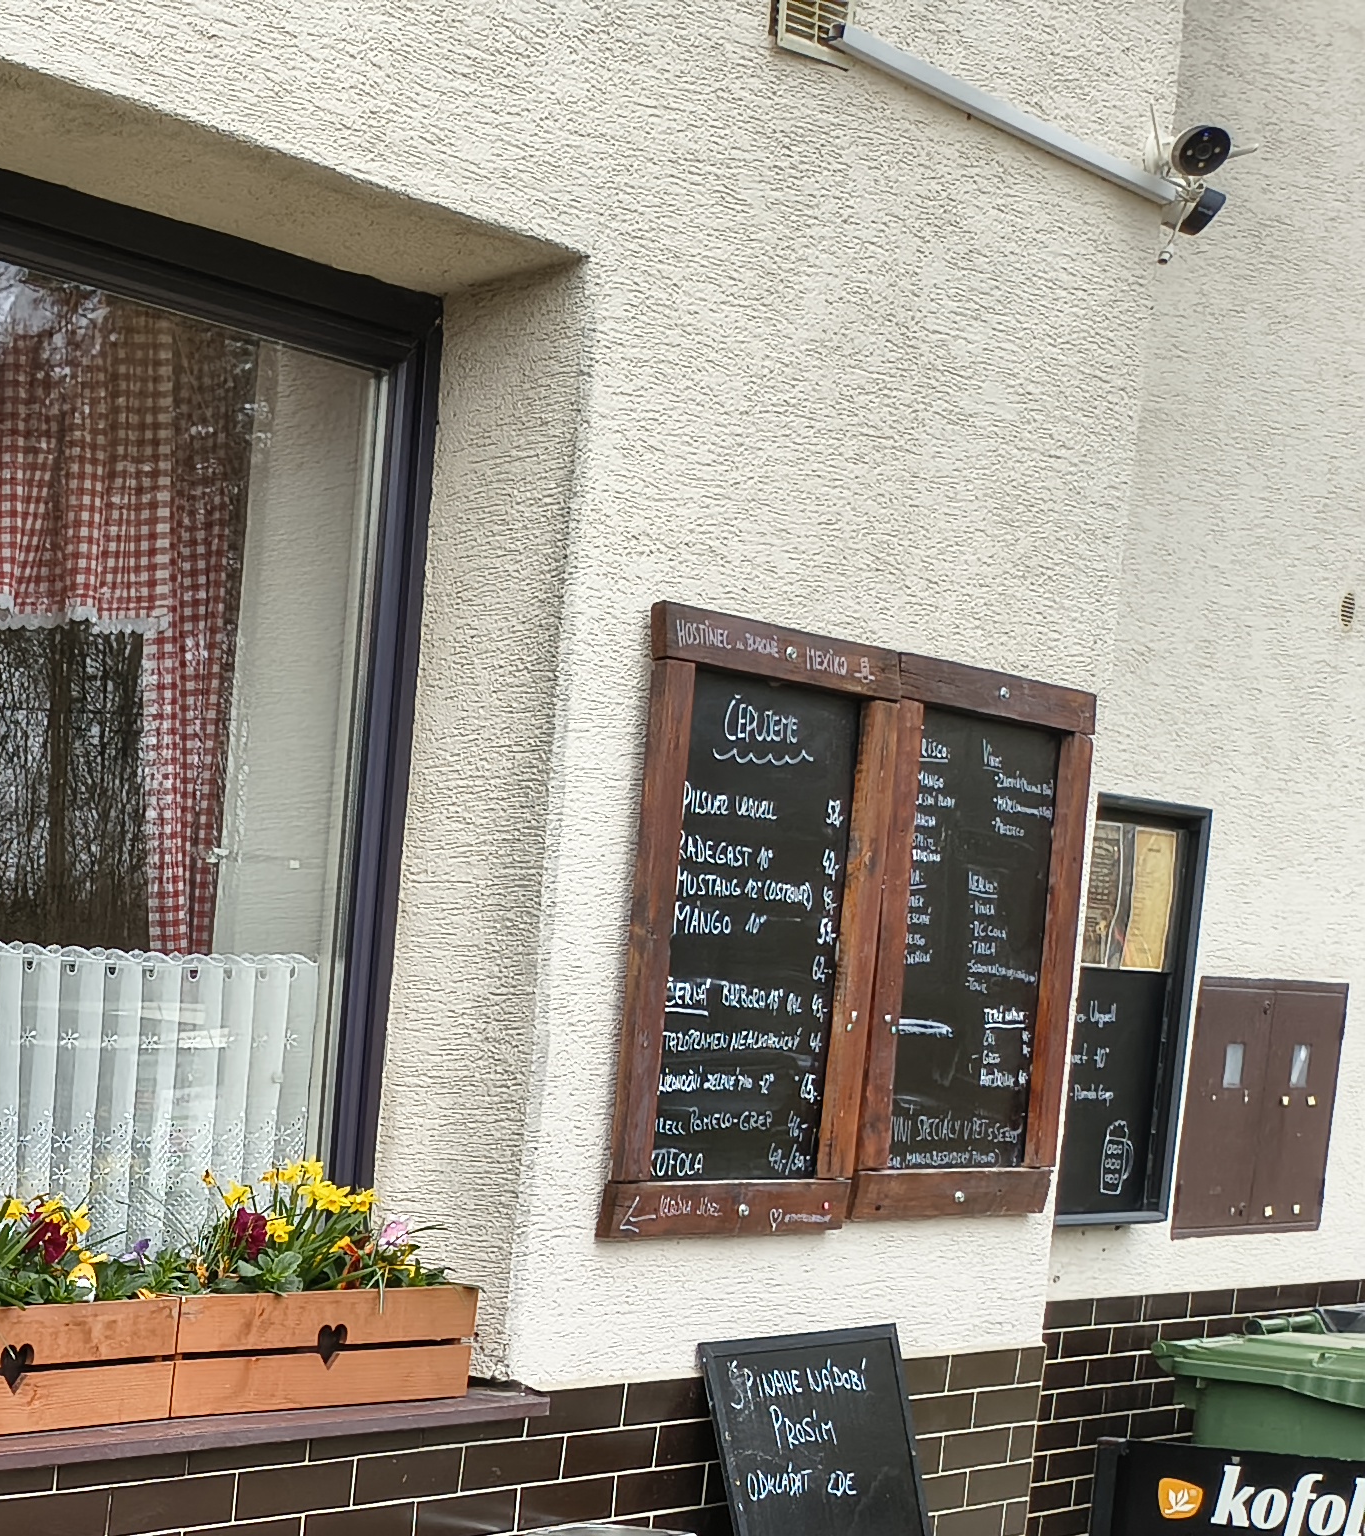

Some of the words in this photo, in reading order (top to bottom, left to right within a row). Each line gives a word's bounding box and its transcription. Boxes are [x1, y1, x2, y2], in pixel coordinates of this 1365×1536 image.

[676, 619, 732, 650] HOSTINEC
[806, 646, 848, 676] MEXIKO
[724, 693, 799, 744] ČEPUJEME
[678, 829, 753, 867] RADEGAST
[675, 865, 741, 897] MUSTANG
[673, 901, 732, 935] MANGO
[662, 1029, 729, 1053] TAROPRAMEN
[806, 1357, 867, 1396] NÁDOBÍ
[769, 1405, 837, 1455] PROSÍM
[747, 1462, 813, 1502] ODKLÁDAT
[827, 1470, 857, 1497] ZDE
